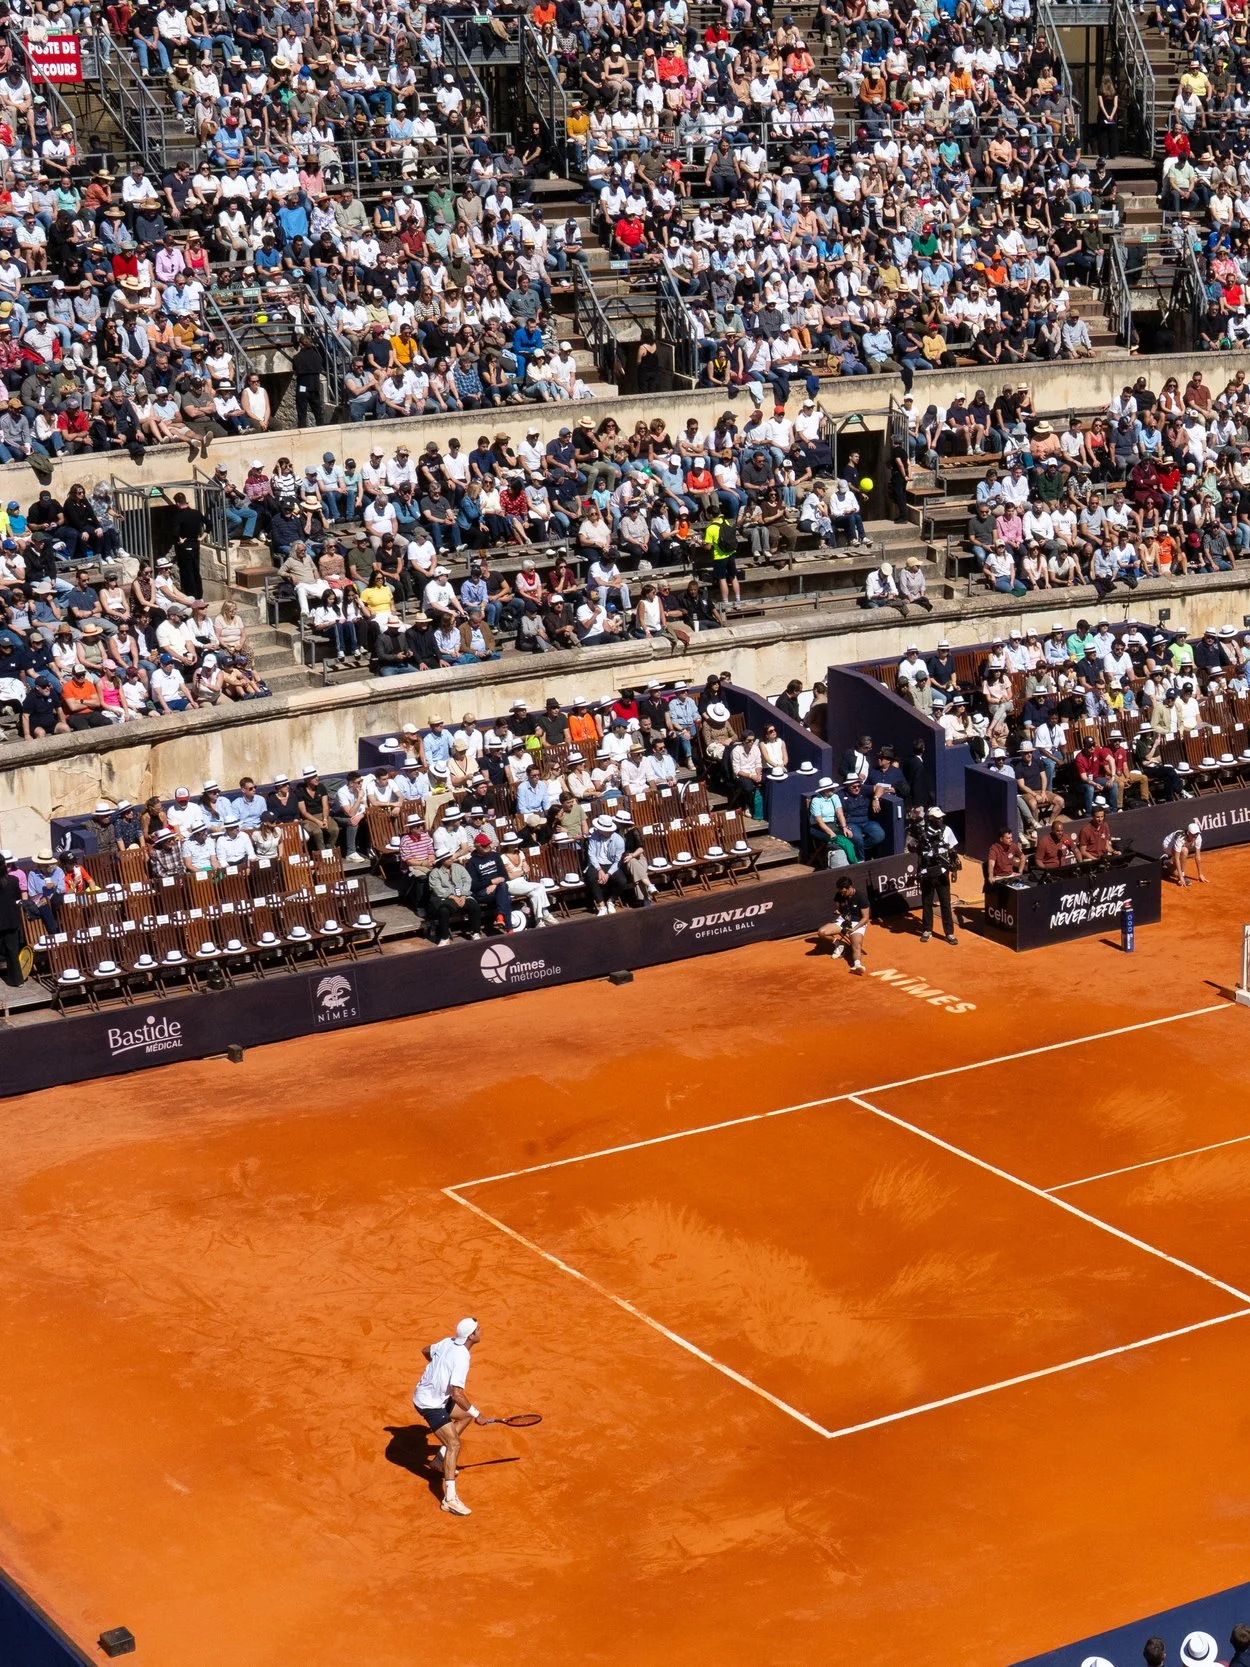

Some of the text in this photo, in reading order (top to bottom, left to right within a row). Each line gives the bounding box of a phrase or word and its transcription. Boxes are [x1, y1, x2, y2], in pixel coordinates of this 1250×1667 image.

[61, 41, 77, 55] DE
[1193, 811, 1228, 831] Midi
[1100, 883, 1127, 903] LIKE
[689, 901, 774, 930] DUNLOP
[988, 907, 1014, 926] celio
[1049, 908, 1087, 929] NEVER
[695, 920, 755, 939] OFFICIAL BALL
[509, 959, 546, 974] nîmes
[510, 966, 562, 983] métropole
[869, 968, 977, 1014] NÎMES
[317, 1007, 357, 1023] NÎMES
[108, 1015, 182, 1049] Bastide
[145, 1039, 183, 1054] MÉDICAL
